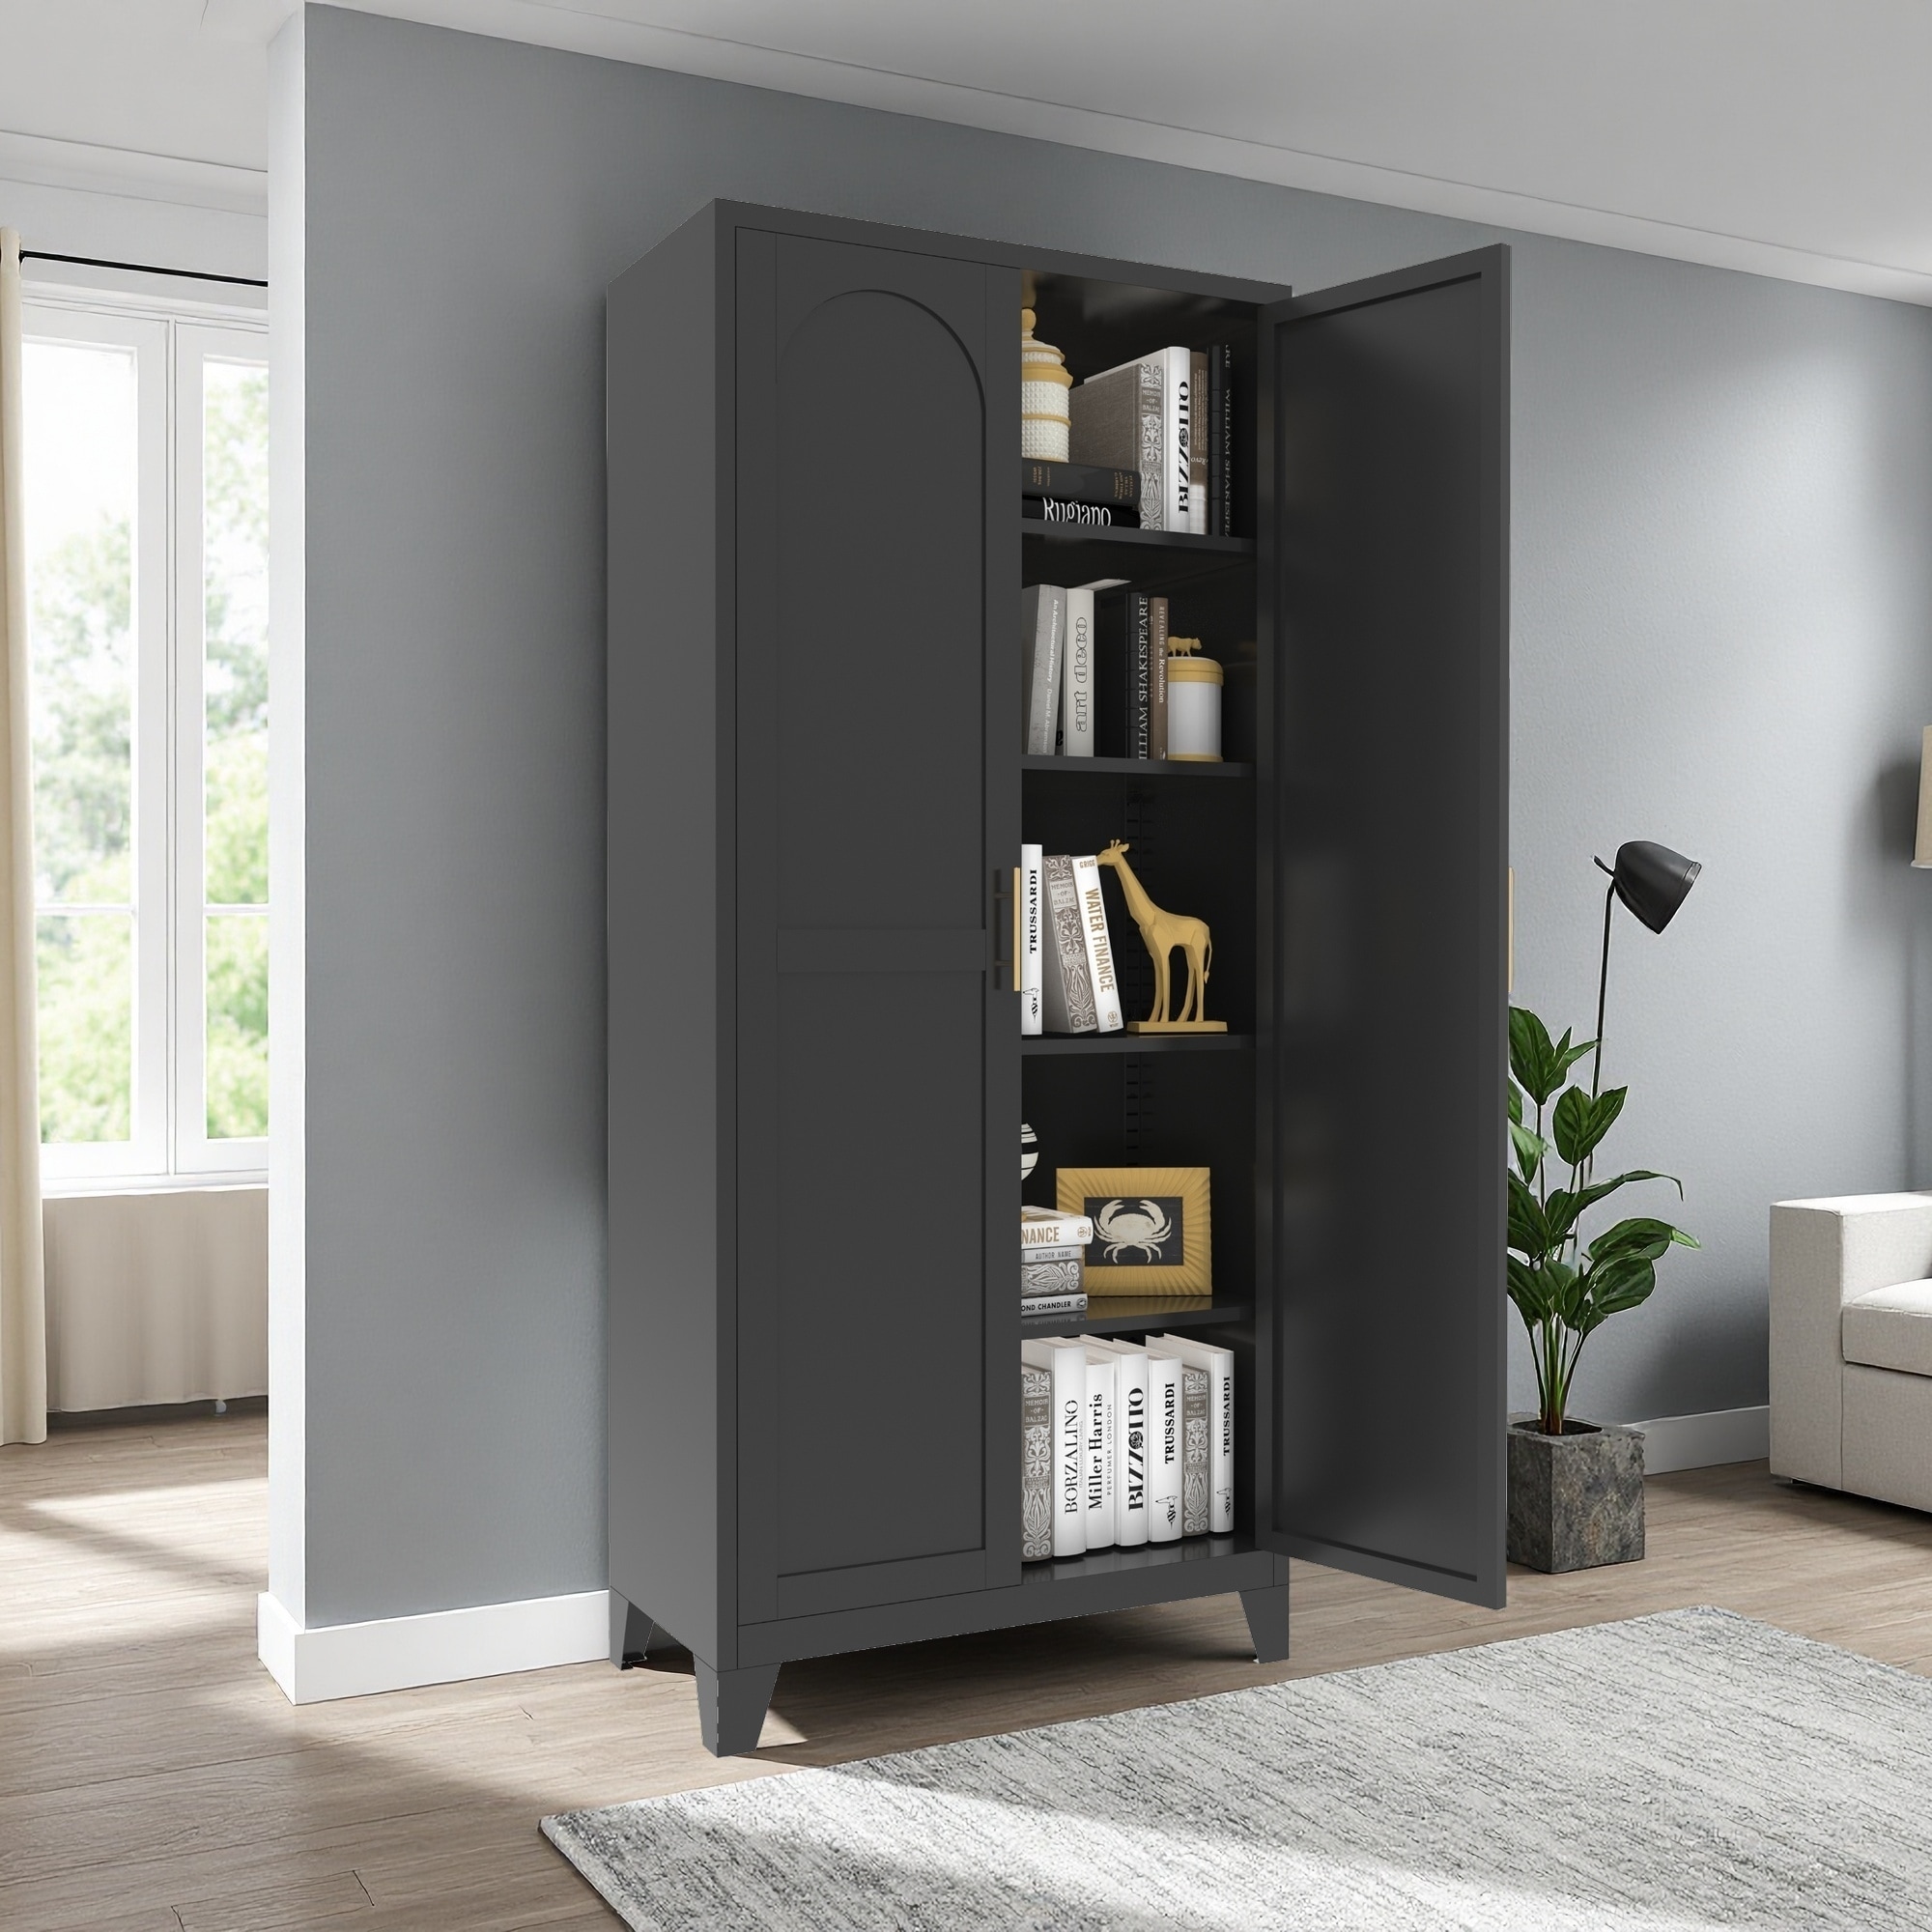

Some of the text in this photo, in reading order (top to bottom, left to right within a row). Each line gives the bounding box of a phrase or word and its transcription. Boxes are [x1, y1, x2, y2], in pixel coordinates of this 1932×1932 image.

[1050, 610, 1059, 657] Architectural
[1053, 599, 1059, 610] An
[1074, 616, 1088, 732] art deco
[1138, 596, 1149, 702] SHAKESPEARE
[1029, 869, 1038, 954] TRUSSARDI
[1051, 881, 1074, 891] MEMOIR
[1085, 887, 1116, 993] WATER FINANCE
[1036, 1251, 1056, 1260] AUTHOR
[1037, 1300, 1072, 1310] CHANDLER
[1025, 1398, 1049, 1406] MEMOIR
[1164, 1382, 1175, 1464] TRUSSARDI
[1065, 1400, 1079, 1515] BORZALINO
[1089, 1393, 1103, 1511] Miller Harris
